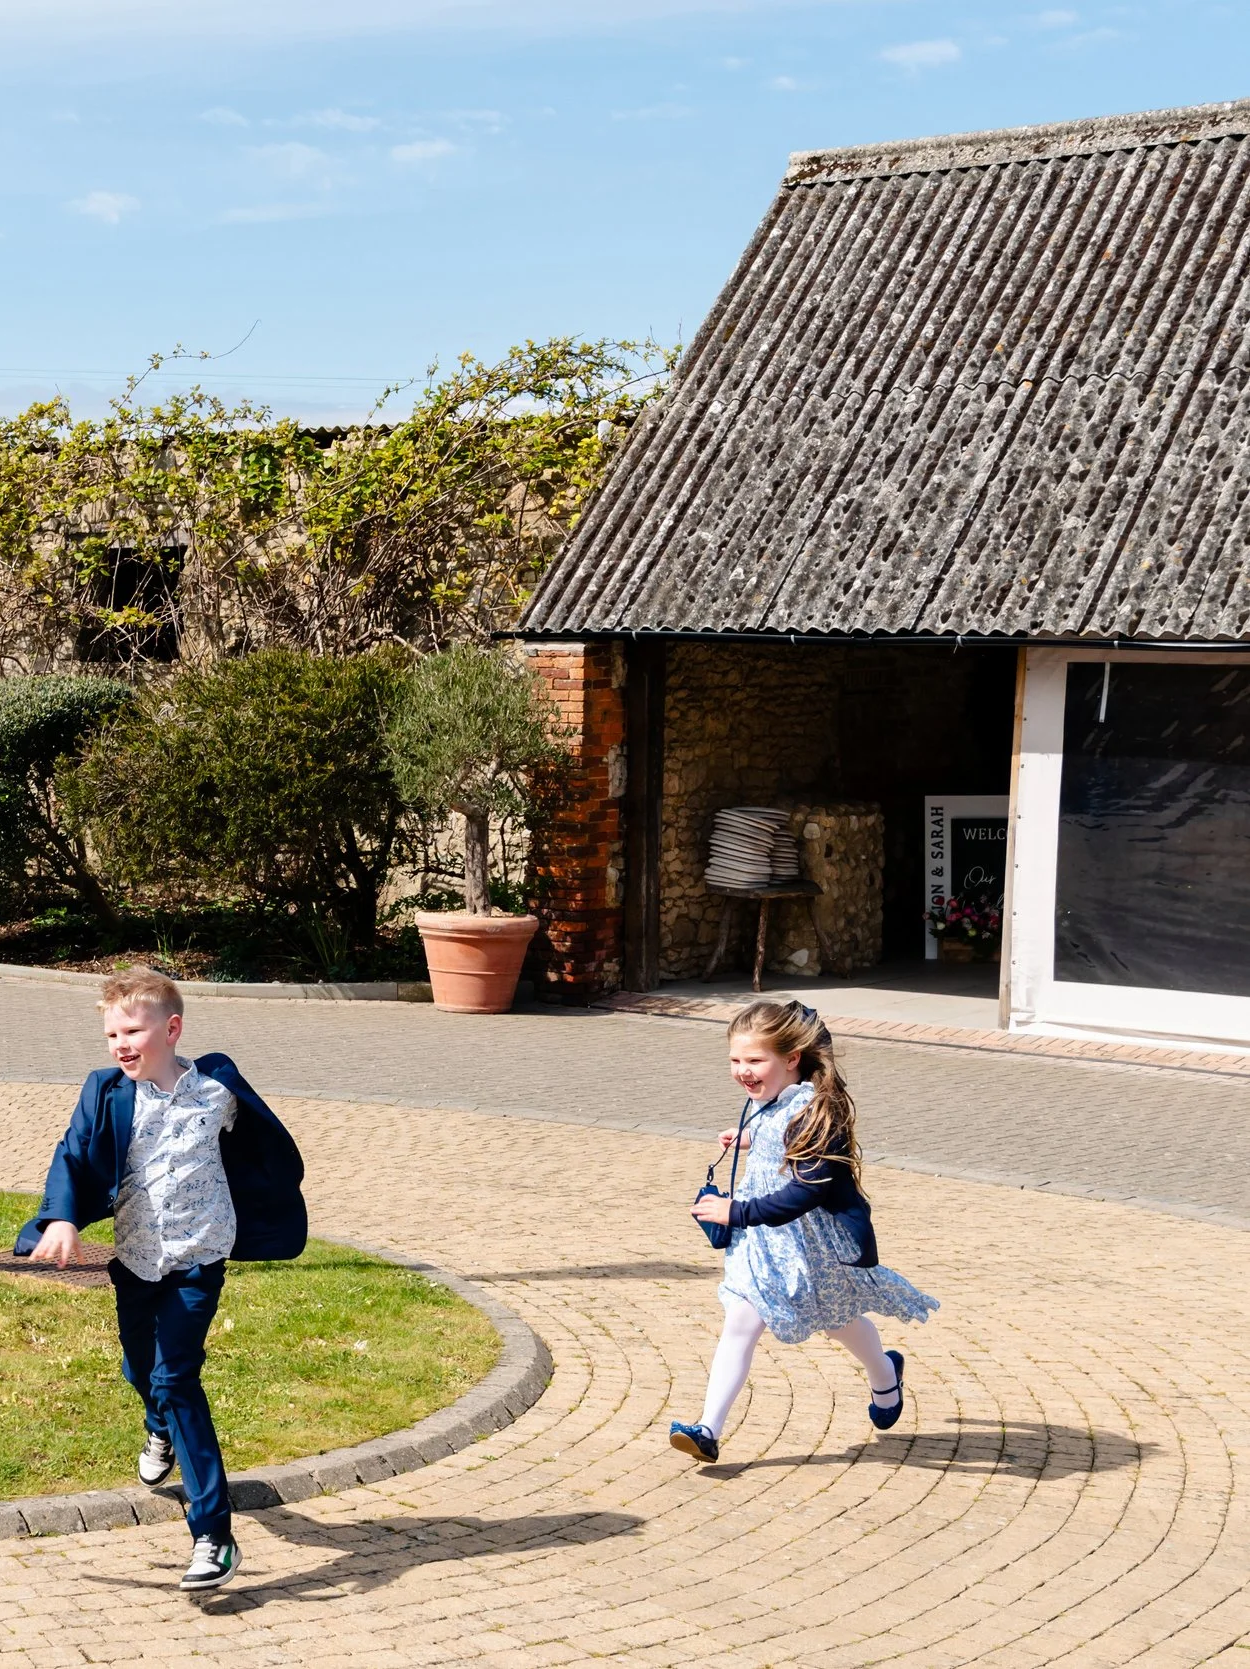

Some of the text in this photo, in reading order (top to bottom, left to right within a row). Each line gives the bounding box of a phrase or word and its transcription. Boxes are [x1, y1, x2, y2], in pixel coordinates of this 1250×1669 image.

[931, 806, 944, 859] SARAH
[963, 827, 1007, 841] WELC
[931, 866, 944, 877] &
